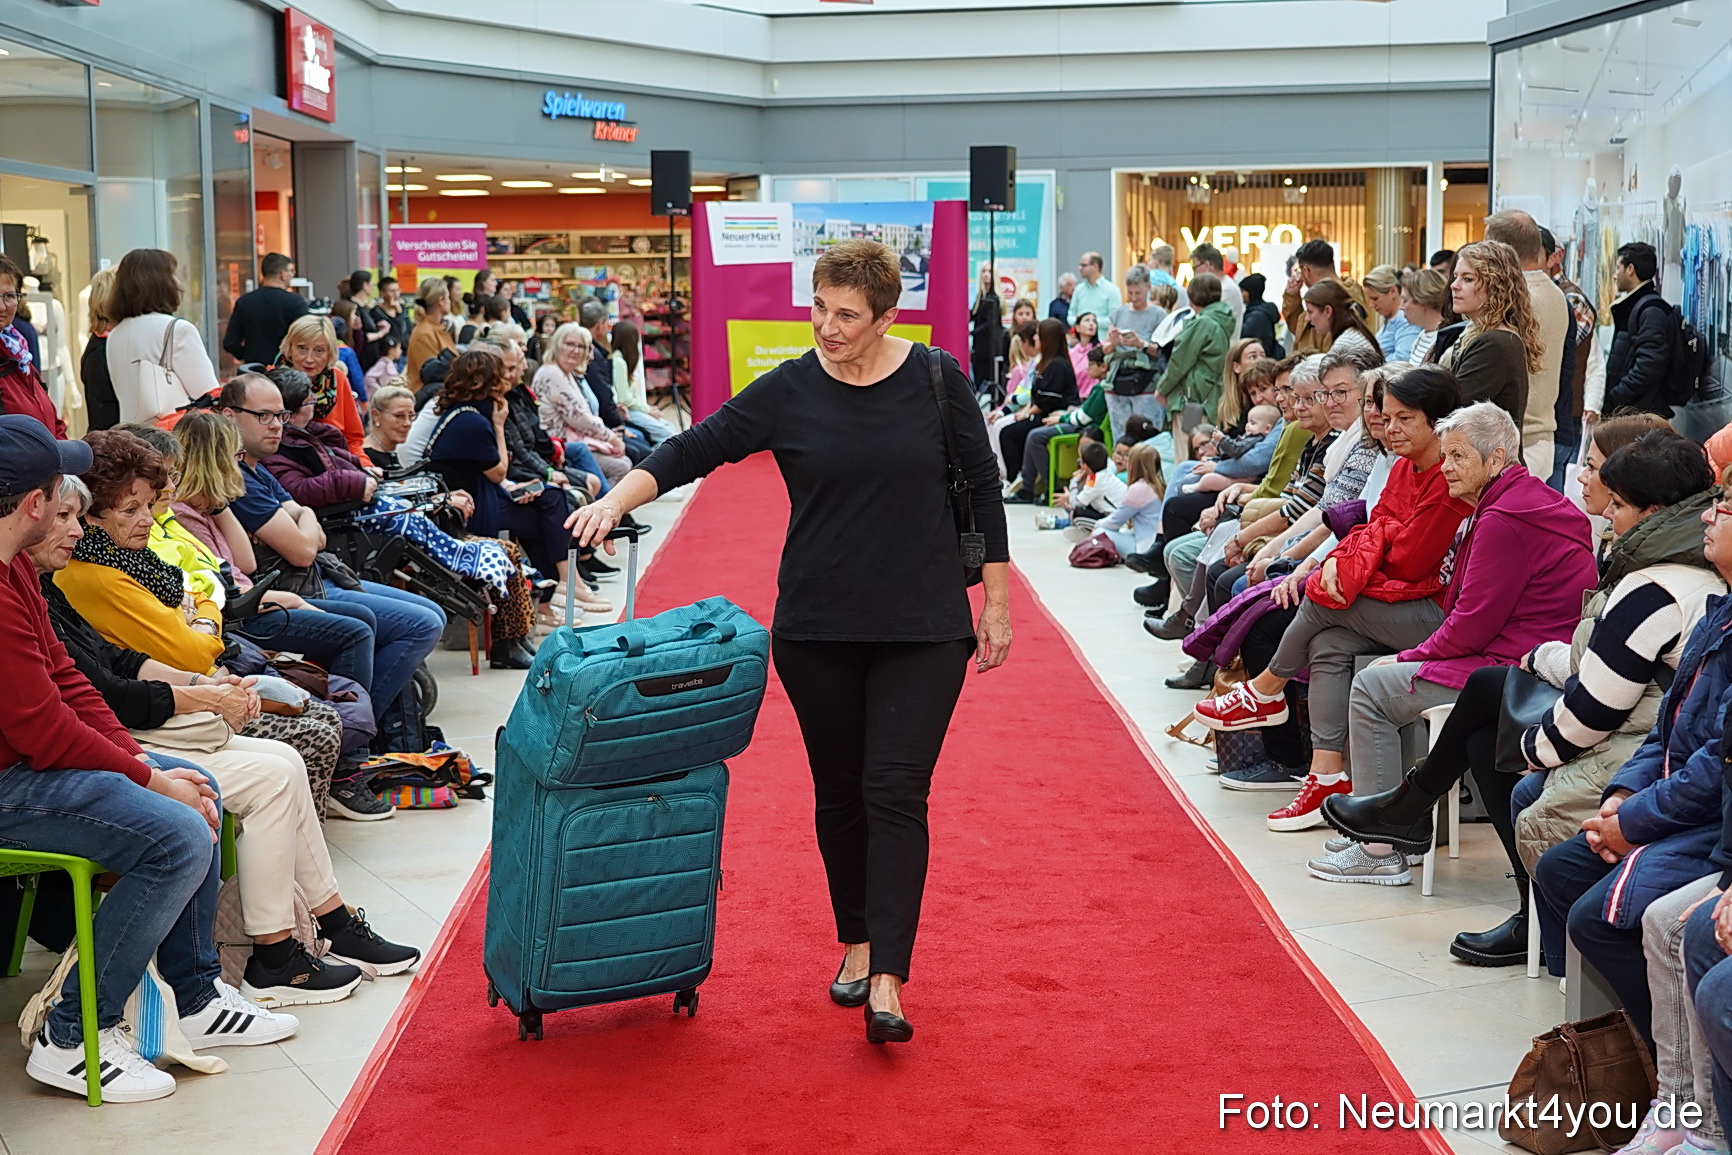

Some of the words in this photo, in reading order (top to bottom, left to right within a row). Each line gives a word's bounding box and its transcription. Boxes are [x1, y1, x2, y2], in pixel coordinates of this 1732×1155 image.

[543, 90, 626, 120] Spielwaren
[722, 232, 781, 241] NeuerMarkt
[1180, 224, 1303, 255] VERO
[396, 240, 460, 251] Verschenken
[461, 239, 478, 251] Sie
[417, 251, 479, 262] Gutscheine!
[754, 346, 768, 355] Du
[671, 679, 703, 690] travelite
